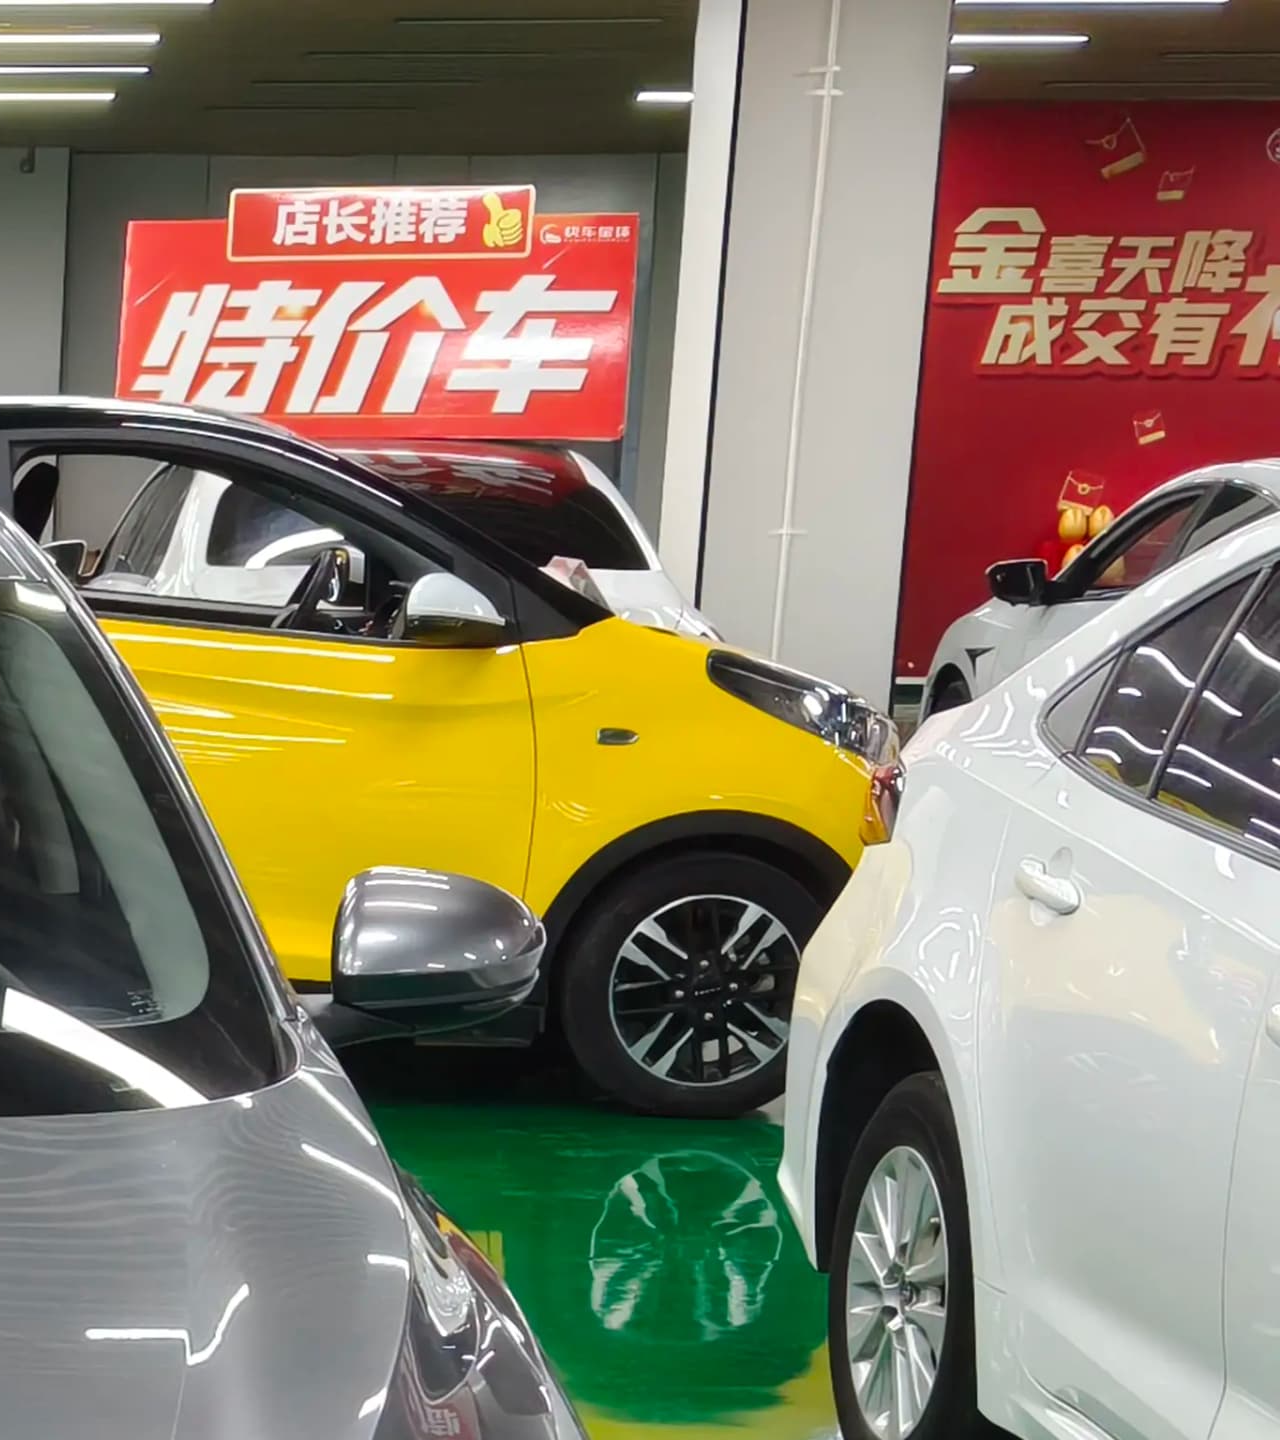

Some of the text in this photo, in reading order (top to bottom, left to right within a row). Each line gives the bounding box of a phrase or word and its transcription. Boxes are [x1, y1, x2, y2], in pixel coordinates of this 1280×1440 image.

[272, 196, 469, 247] 店长推荐
[937, 207, 1253, 294] 金喜天降
[132, 273, 618, 415] 特价车
